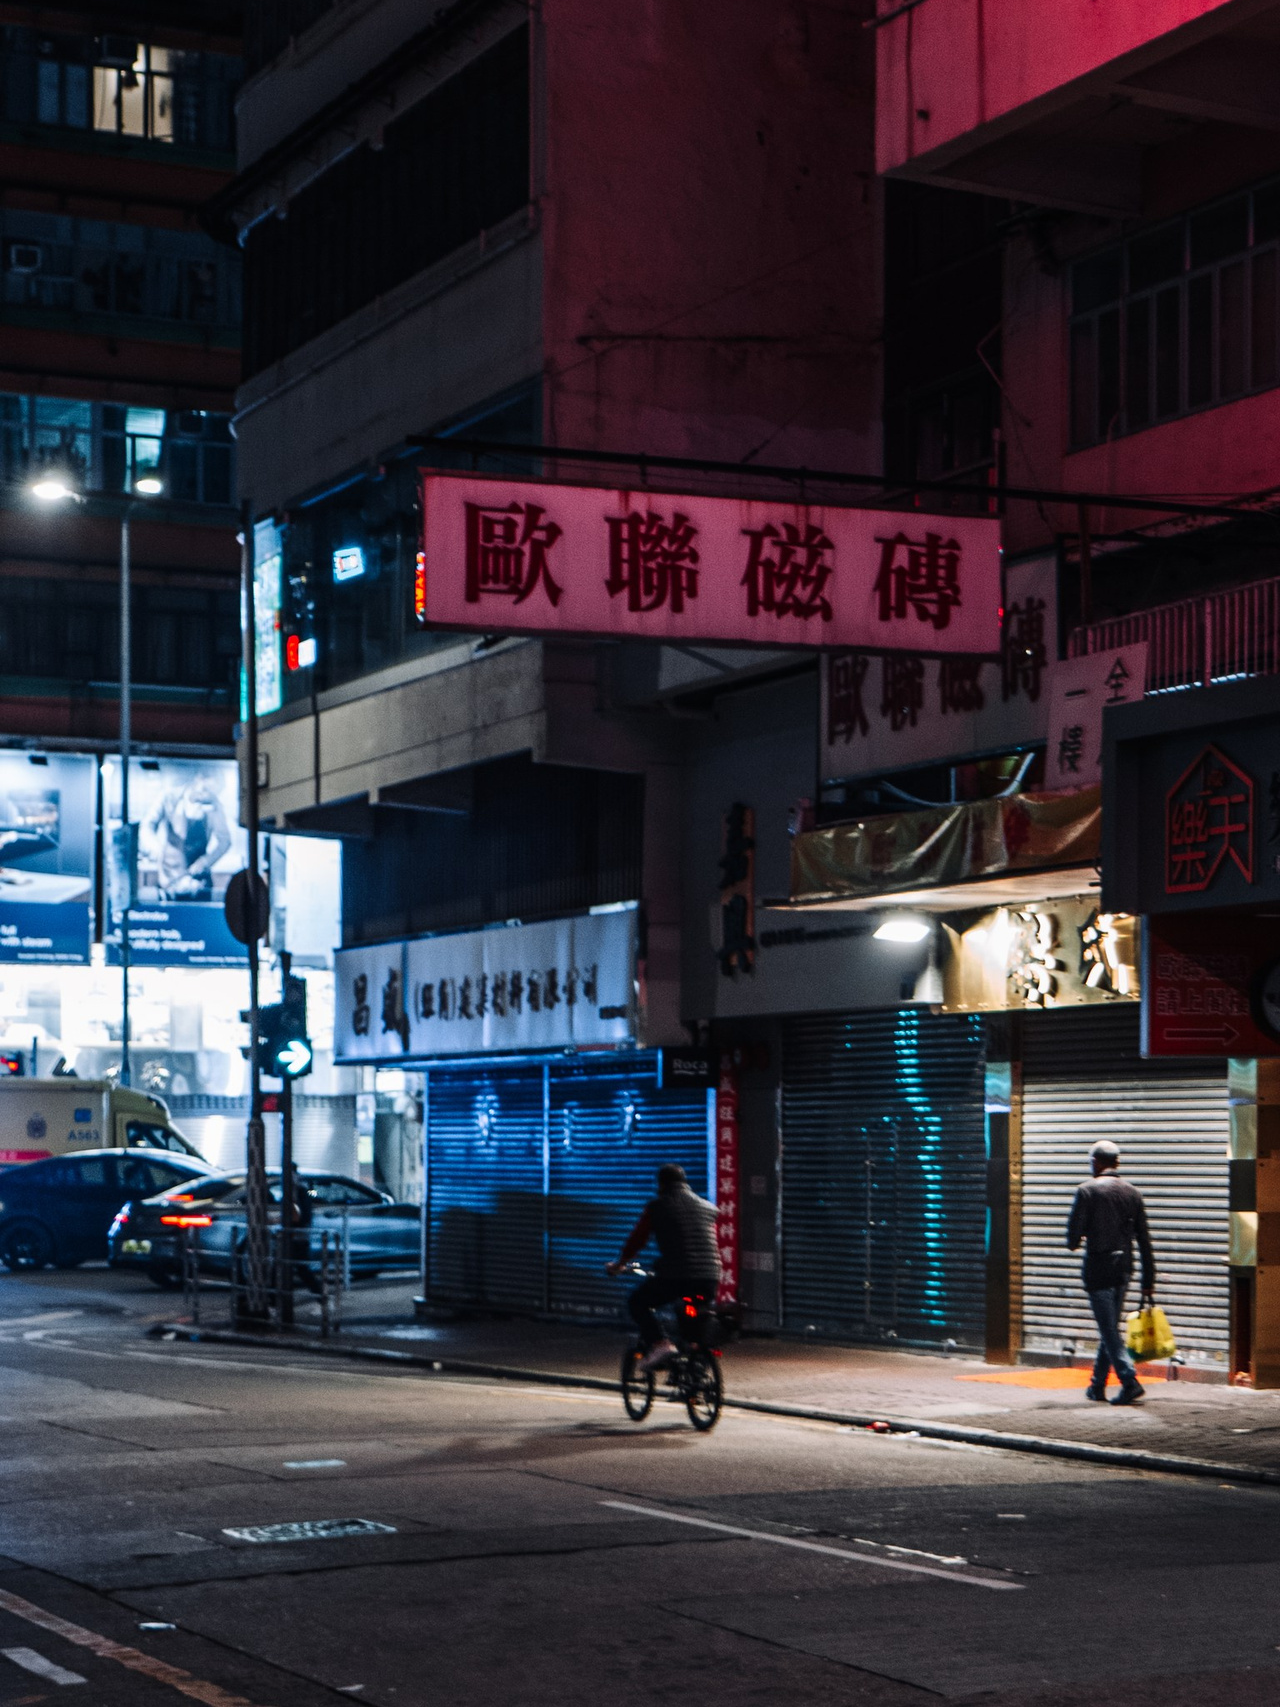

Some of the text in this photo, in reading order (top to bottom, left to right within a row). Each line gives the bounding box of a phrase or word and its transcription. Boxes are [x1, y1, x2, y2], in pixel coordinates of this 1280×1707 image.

[463, 501, 962, 629] 歐聯磁磚
[672, 1058, 709, 1071] Roca
